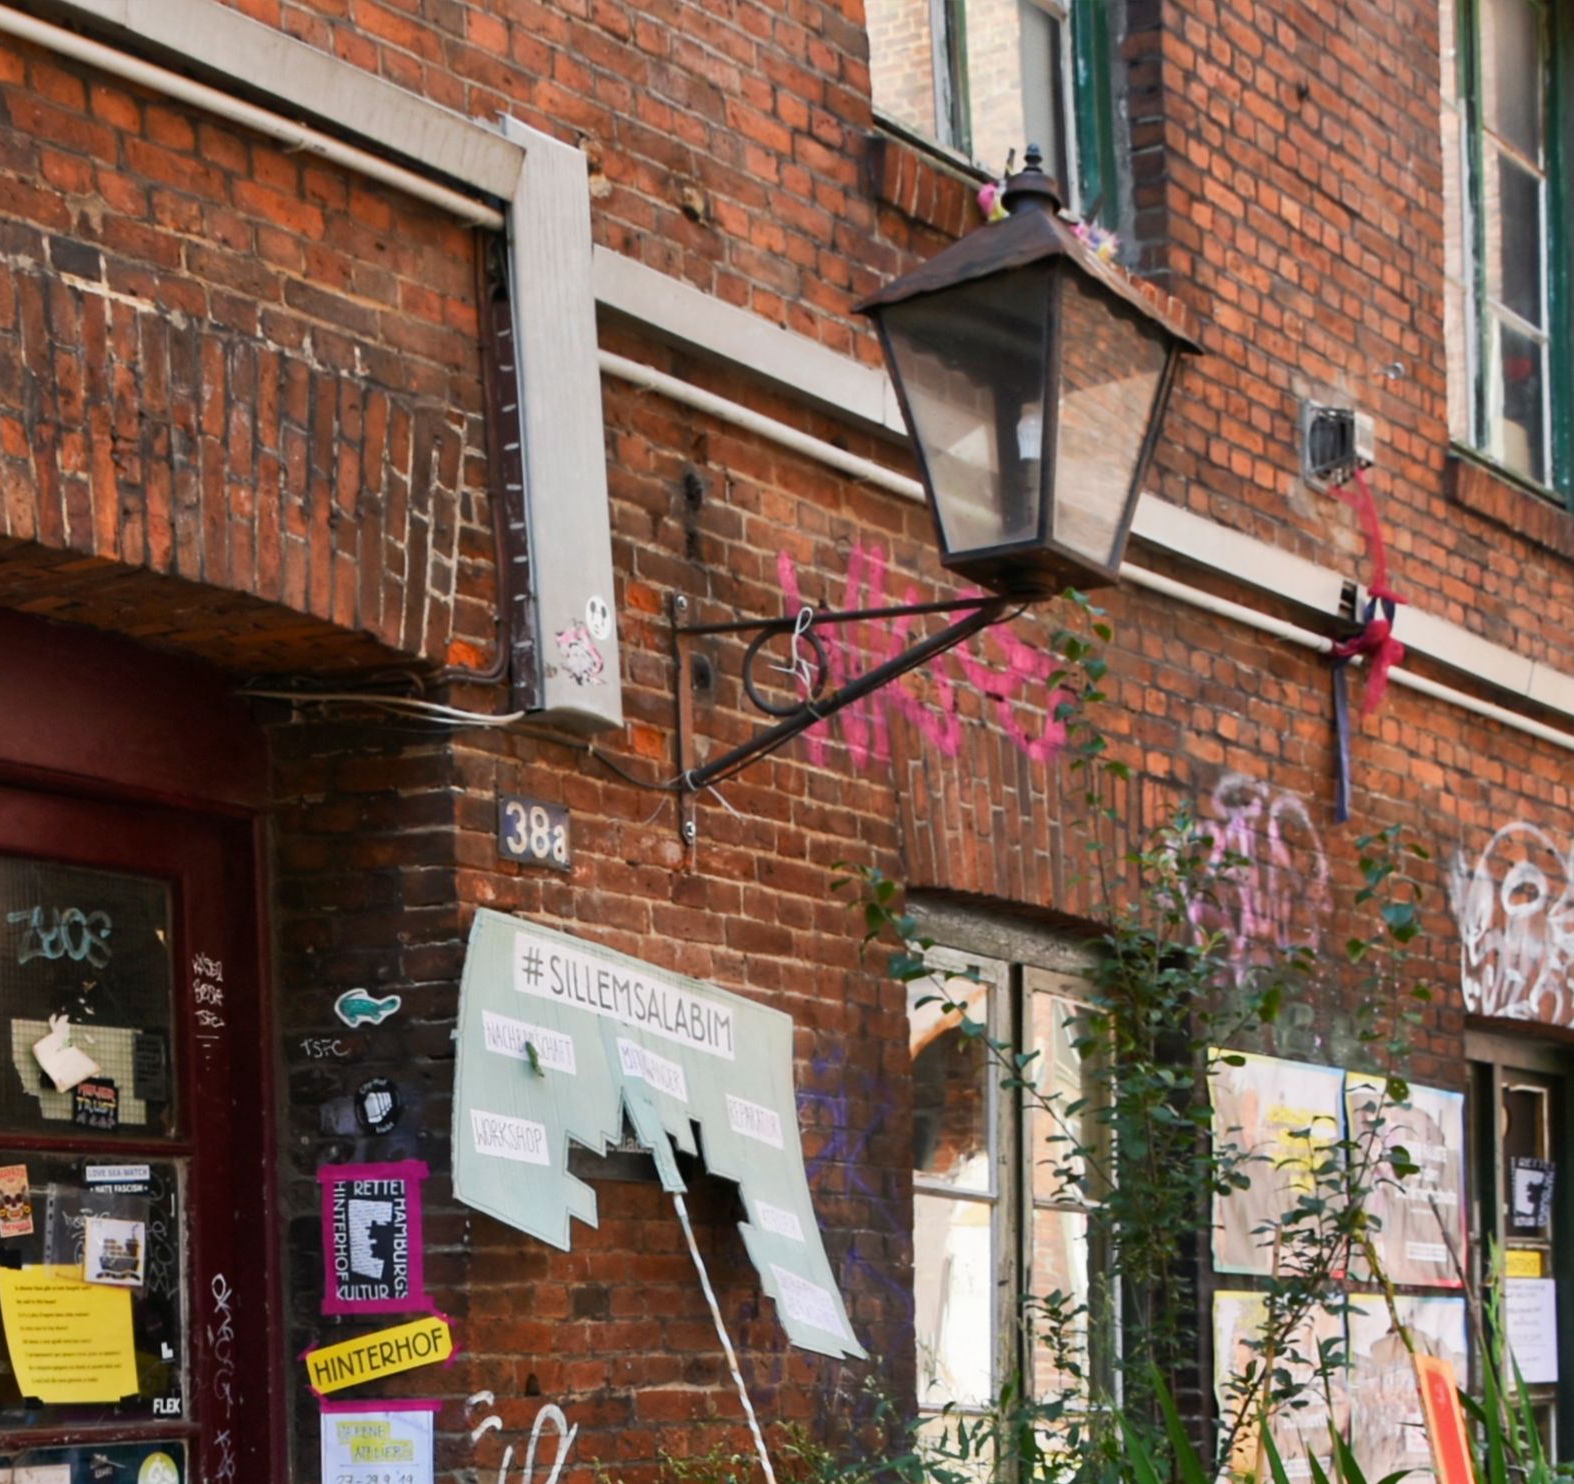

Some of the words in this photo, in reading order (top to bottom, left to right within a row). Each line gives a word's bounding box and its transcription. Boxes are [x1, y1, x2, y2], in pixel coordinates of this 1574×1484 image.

[505, 801, 568, 862] 38a
[476, 1117, 543, 1155] WORKSHOP
[333, 1181, 350, 1281] HINTERHOF
[336, 1284, 389, 1301] KULTUR
[314, 1328, 443, 1386] HINTERHOF
[153, 1397, 181, 1414] FLEX
